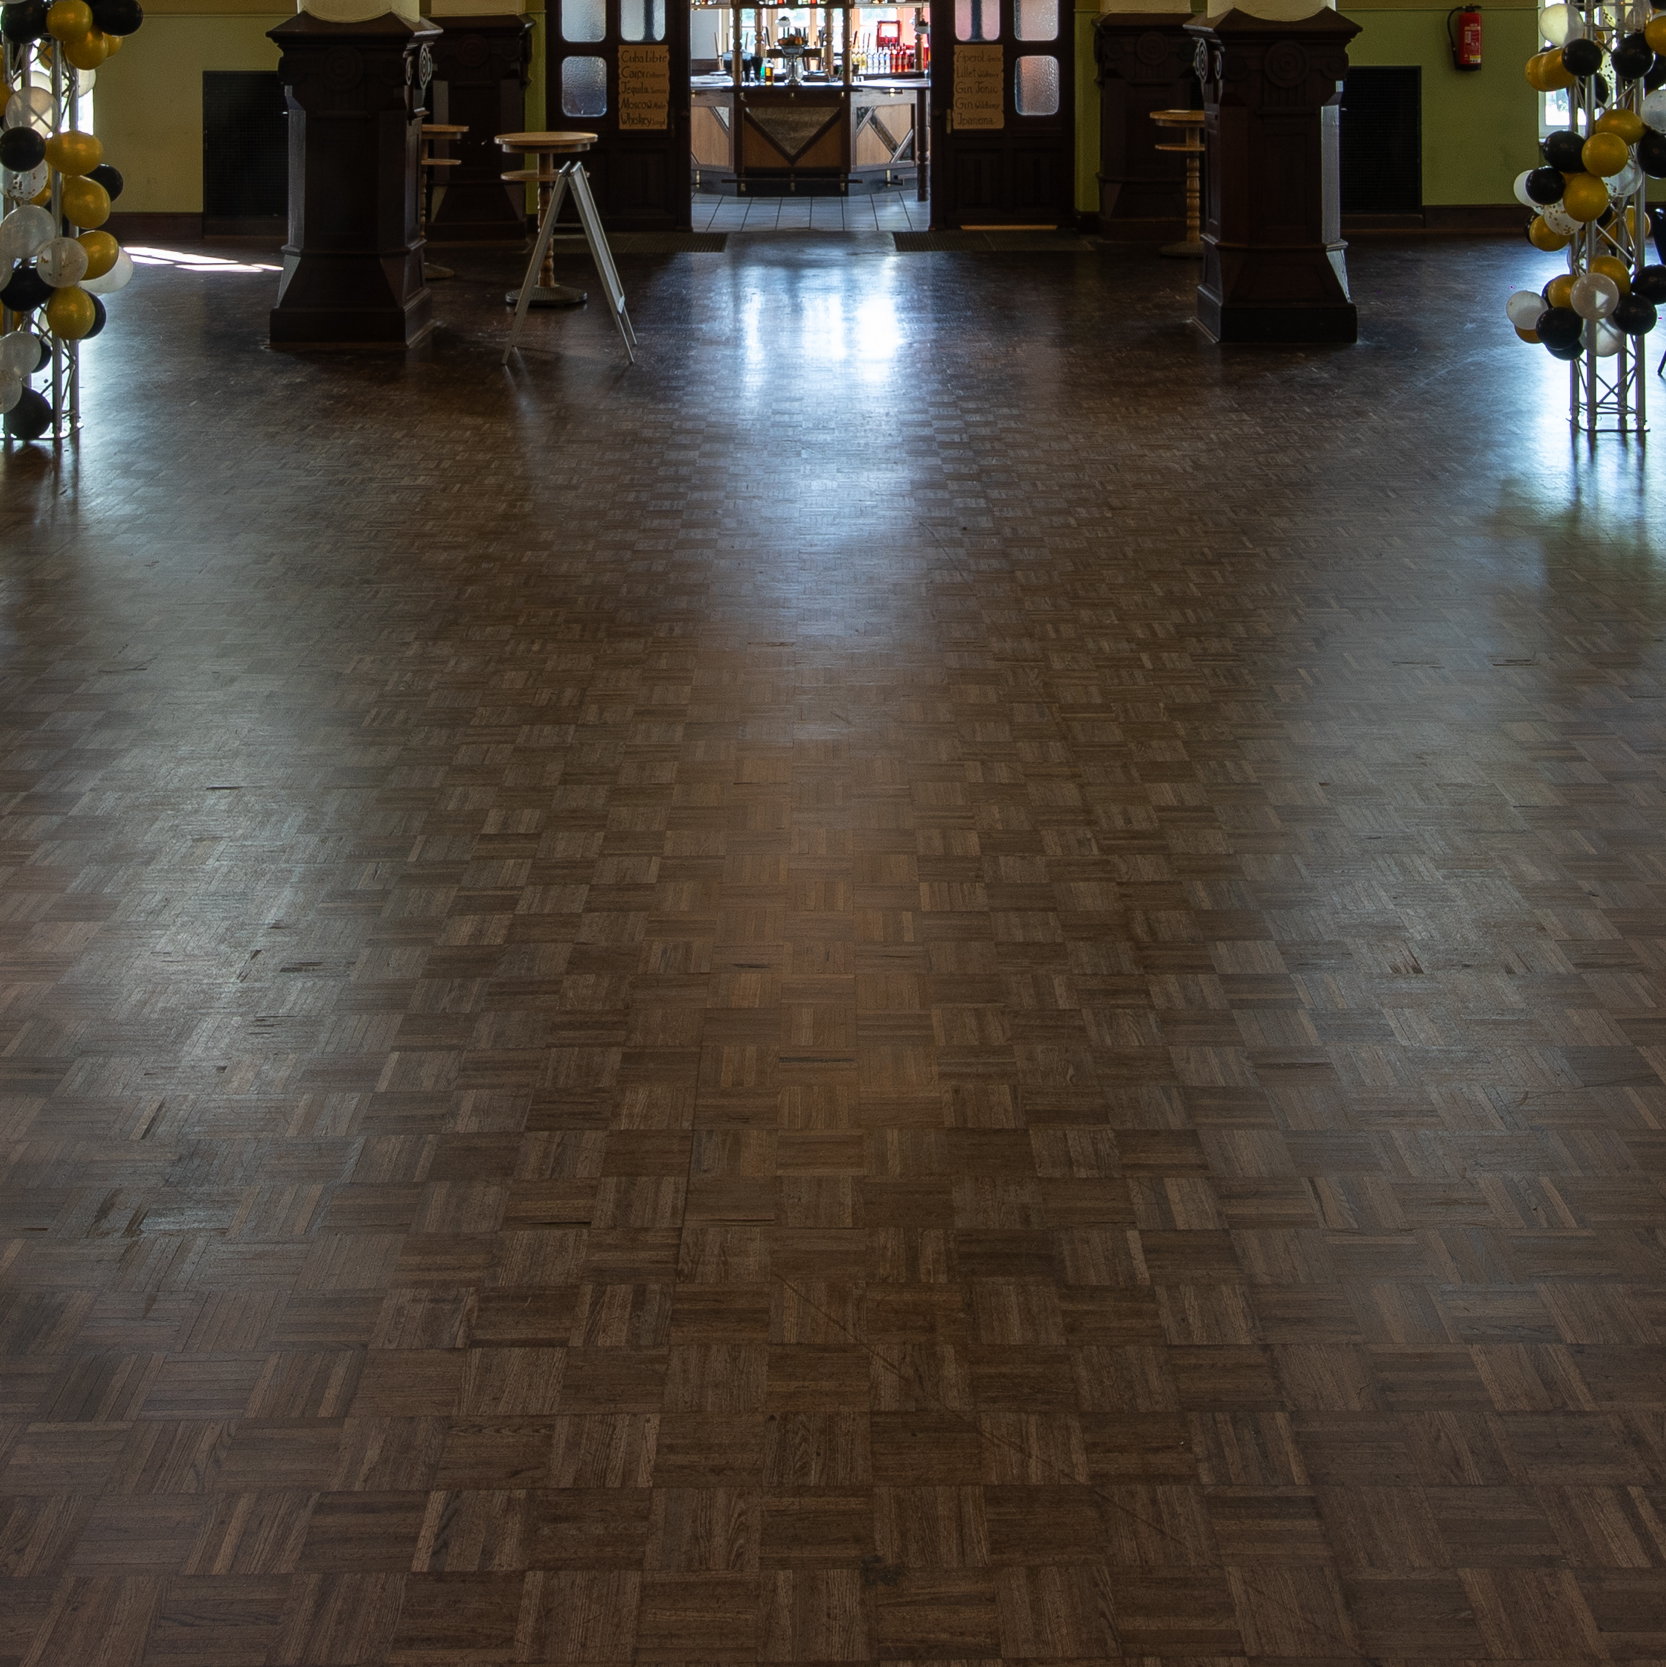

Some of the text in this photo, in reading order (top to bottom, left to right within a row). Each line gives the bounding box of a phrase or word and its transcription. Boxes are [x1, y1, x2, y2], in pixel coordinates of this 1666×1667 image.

[621, 50, 644, 63] Cuba
[955, 81, 999, 94] Gin Tonic
[621, 97, 652, 110] Moscow
[955, 97, 973, 110] Gin
